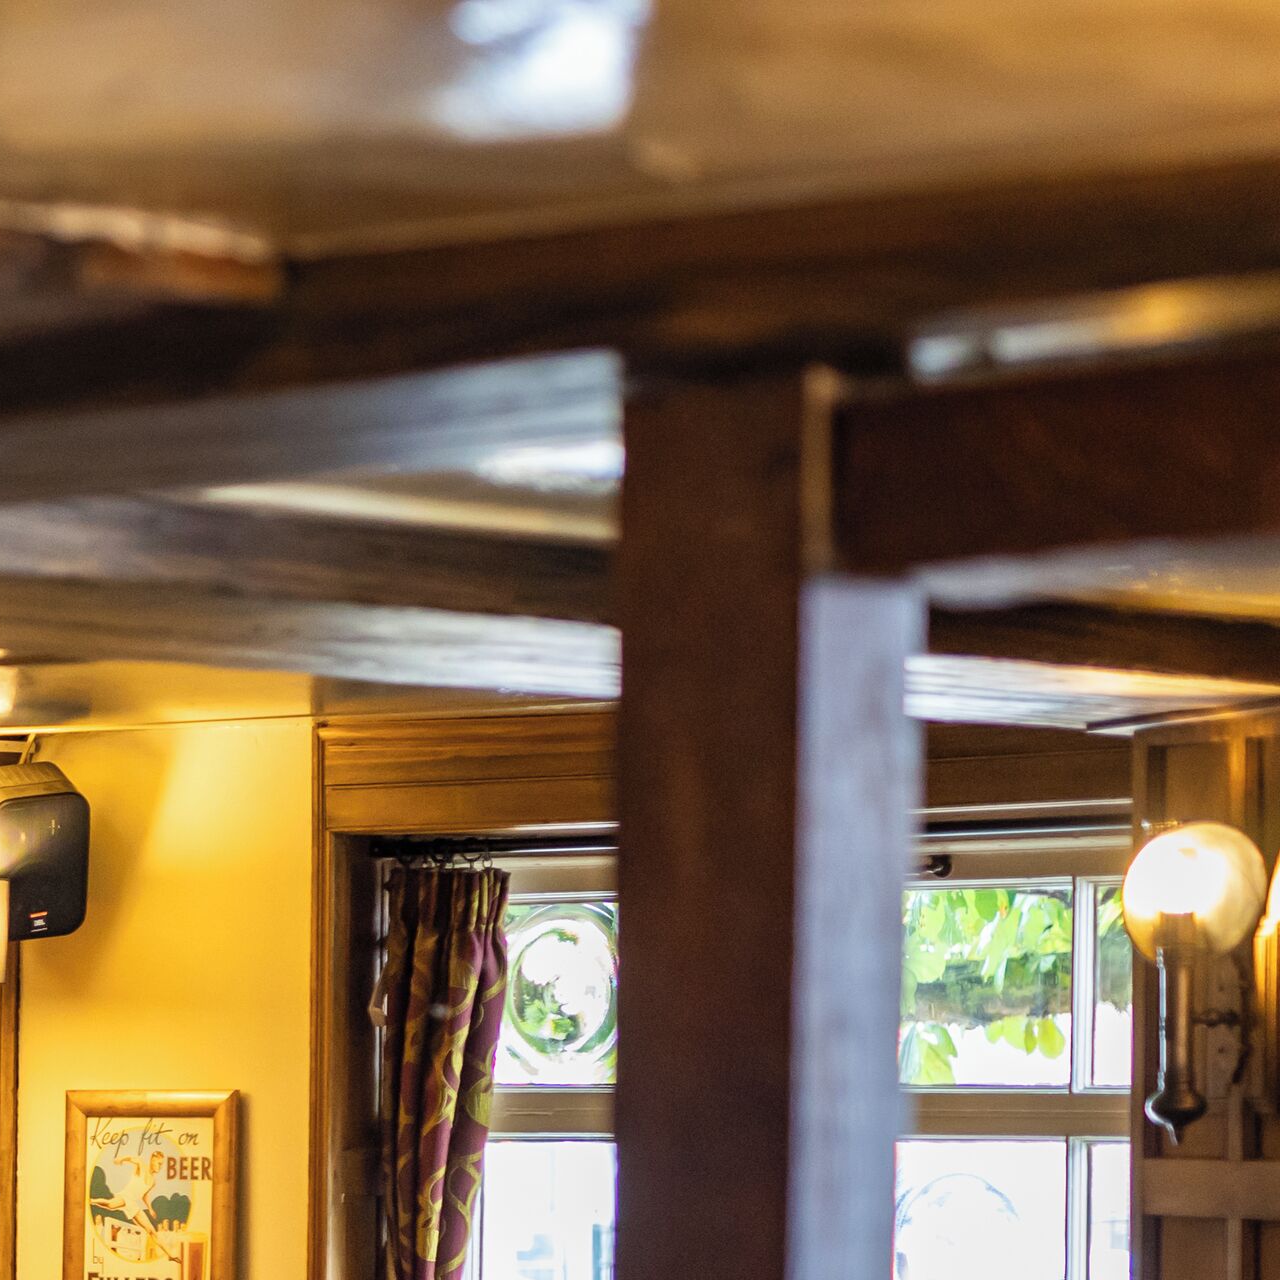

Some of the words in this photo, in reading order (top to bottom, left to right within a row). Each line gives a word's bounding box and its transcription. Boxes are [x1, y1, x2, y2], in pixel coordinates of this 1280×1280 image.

[90, 1117, 129, 1158] Keep
[138, 1117, 173, 1156] fit
[178, 1131, 199, 1146] on
[167, 1156, 212, 1181] BEER
